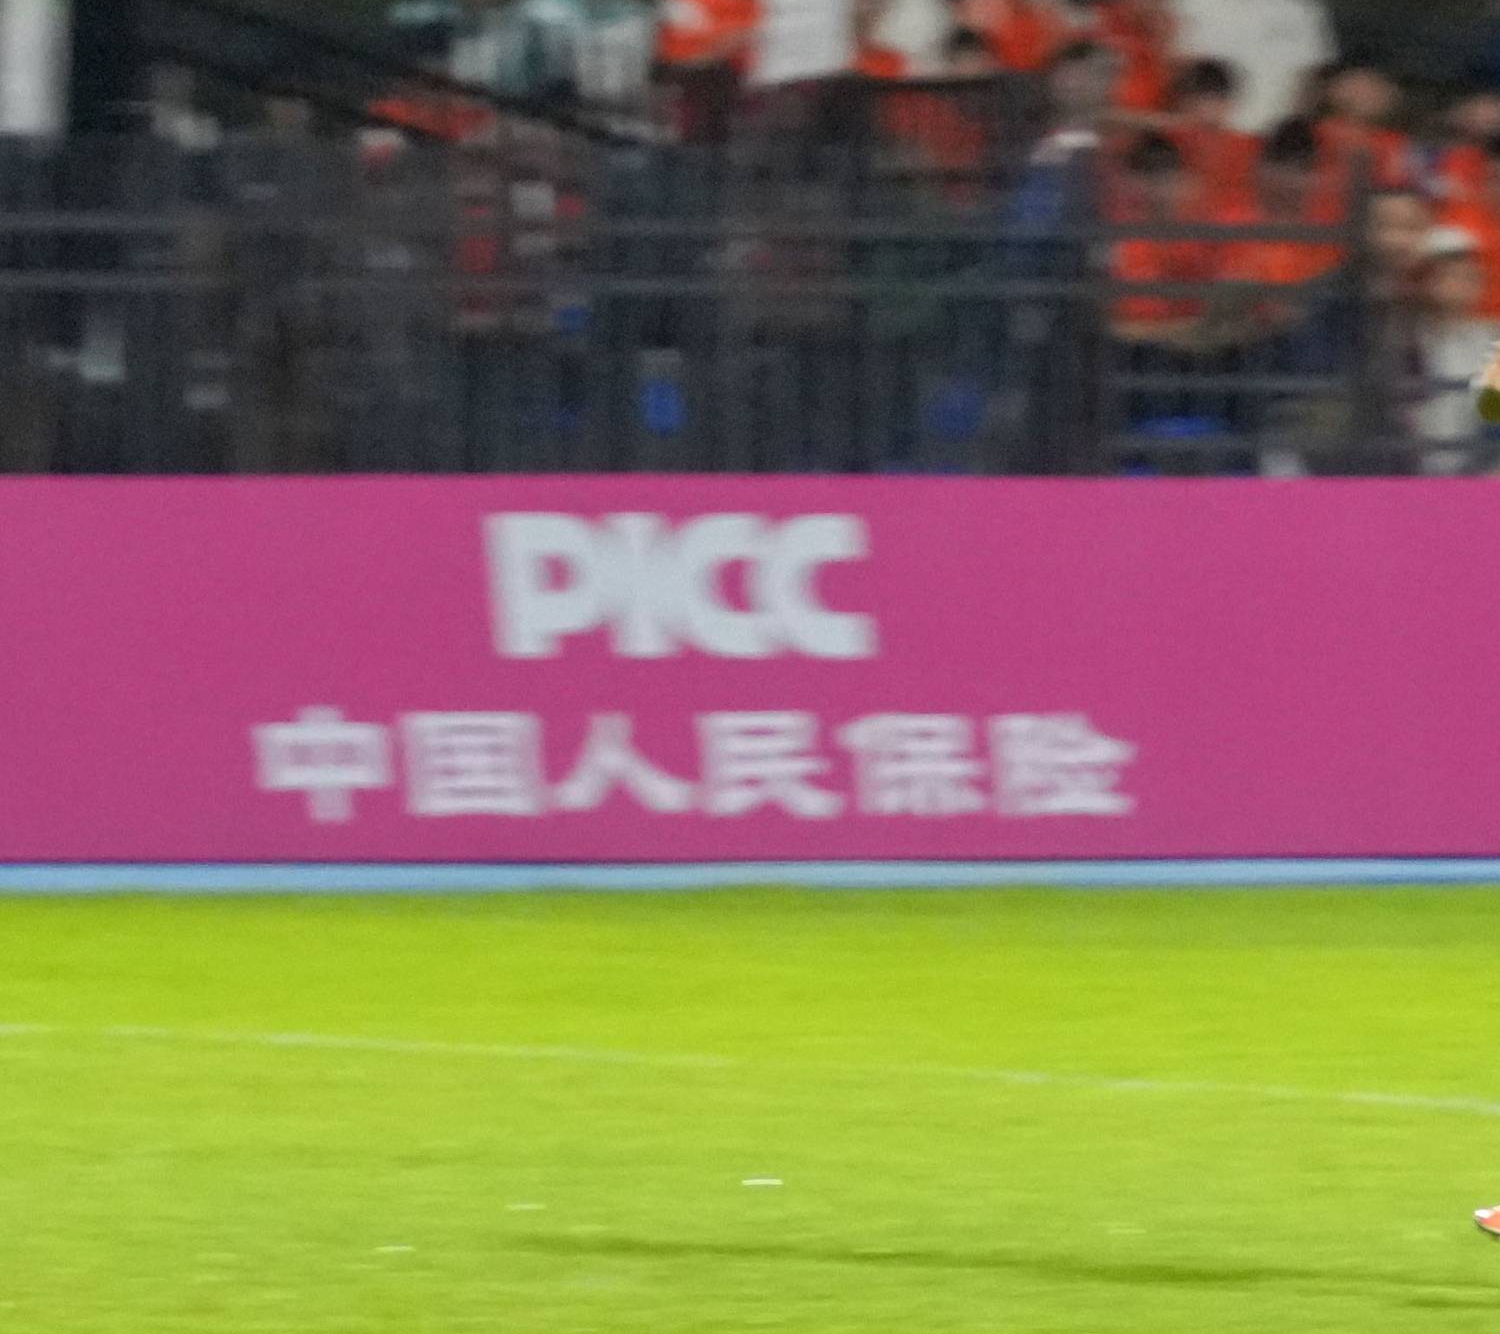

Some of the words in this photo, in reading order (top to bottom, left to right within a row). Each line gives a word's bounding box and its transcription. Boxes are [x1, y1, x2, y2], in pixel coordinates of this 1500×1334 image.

[482, 511, 879, 660] PICC
[249, 704, 1138, 824] 中国人民保险
